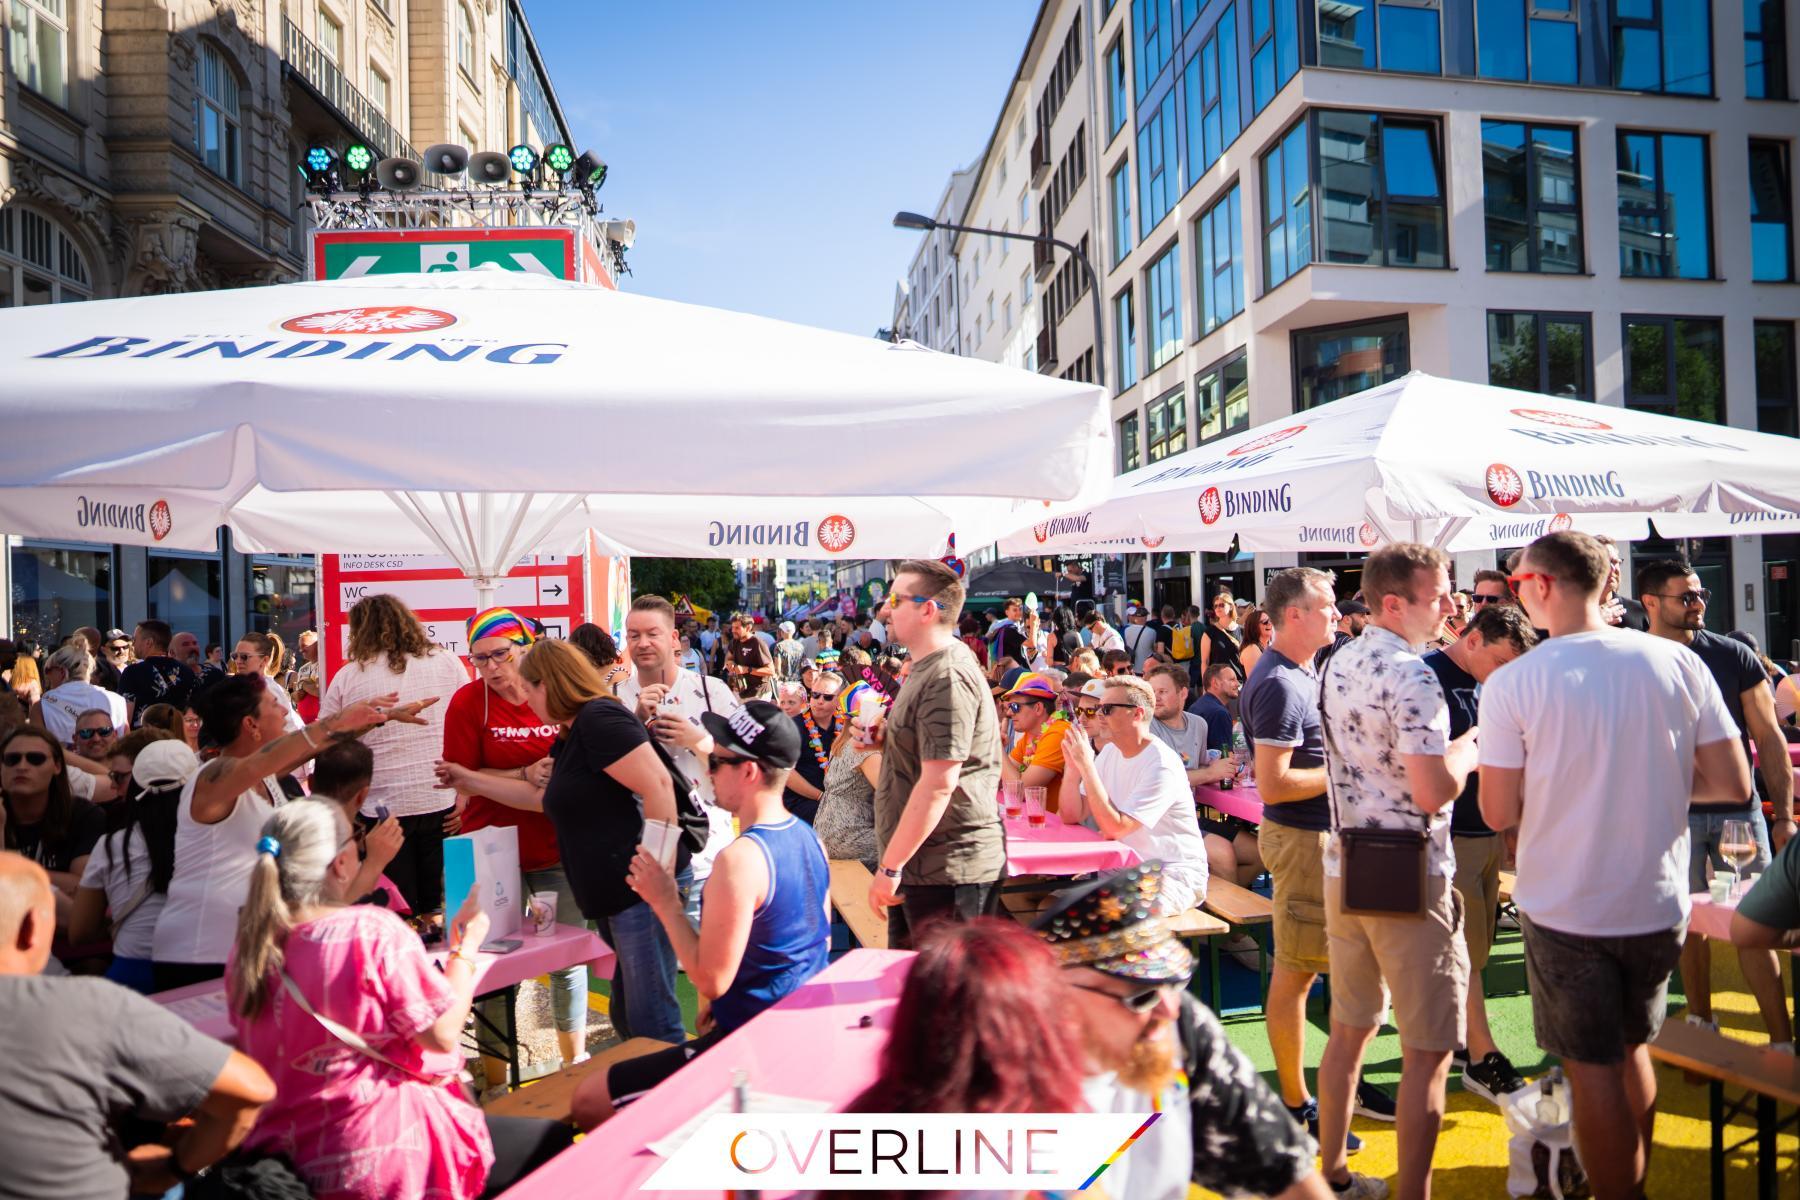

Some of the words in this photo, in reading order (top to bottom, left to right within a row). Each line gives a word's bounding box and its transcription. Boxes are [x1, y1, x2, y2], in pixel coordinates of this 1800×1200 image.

[31, 335, 569, 365] BINDING
[1526, 469, 1625, 499] BINDING
[1225, 483, 1292, 518] BINDING
[1049, 511, 1092, 537] BINDING
[343, 561, 363, 569] INFO
[363, 560, 386, 569] DESK
[386, 560, 404, 568] CSD
[344, 586, 368, 599] WC
